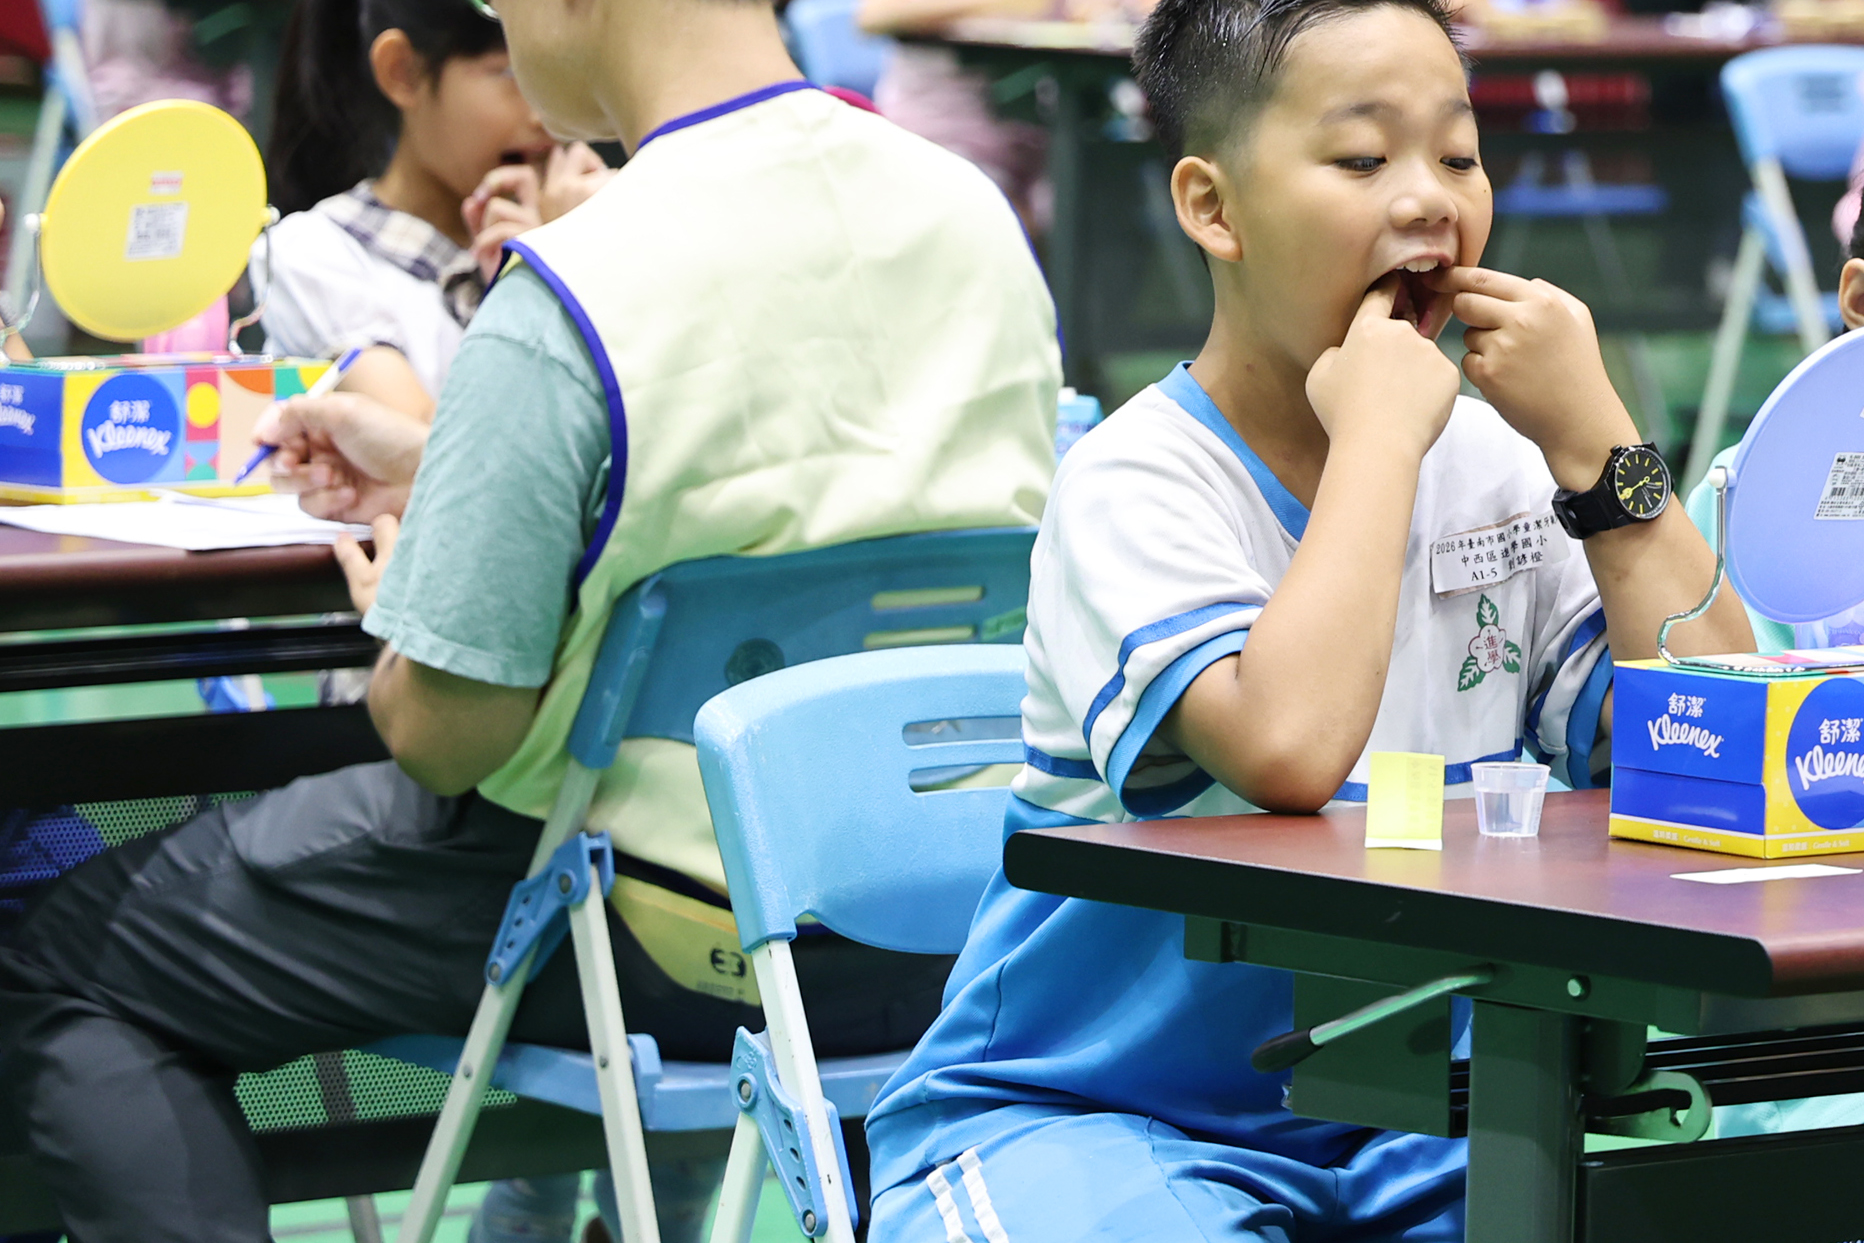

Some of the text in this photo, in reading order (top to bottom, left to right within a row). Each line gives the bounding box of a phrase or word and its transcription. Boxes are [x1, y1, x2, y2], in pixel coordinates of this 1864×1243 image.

[109, 399, 151, 424] 舒潔
[88, 419, 171, 459] Kleenex
[1471, 567, 1498, 581] A1-5
[1667, 692, 1706, 718] 舒潔
[1646, 714, 1724, 759] Kleenex
[1818, 717, 1864, 746] 舒潔
